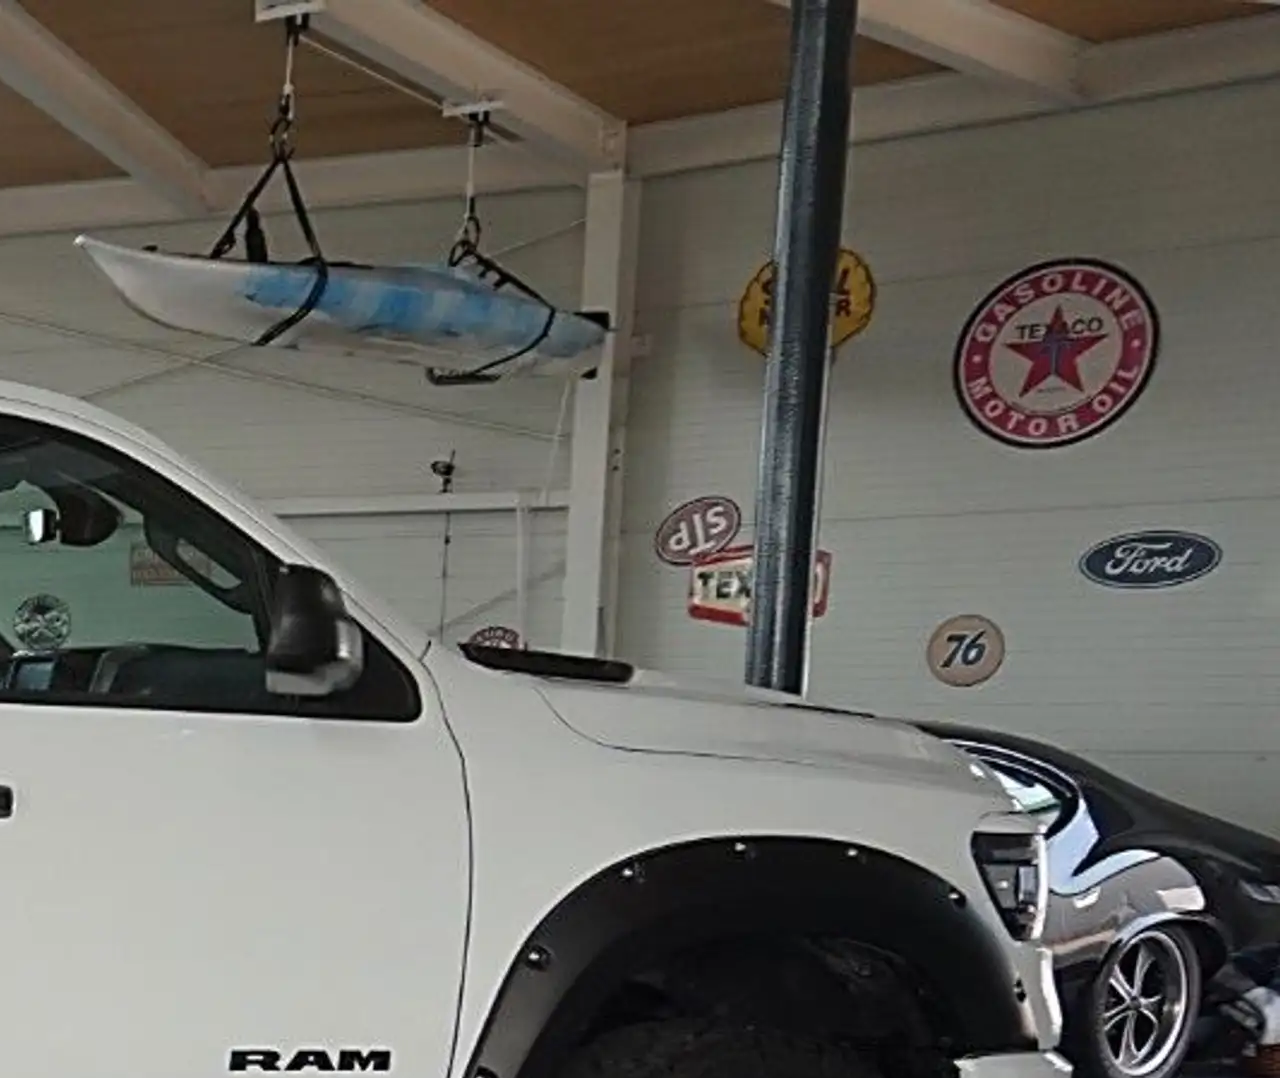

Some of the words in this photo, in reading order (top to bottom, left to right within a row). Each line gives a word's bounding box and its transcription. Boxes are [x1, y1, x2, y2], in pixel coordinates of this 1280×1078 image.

[975, 271, 1143, 343] GASOLINE
[1015, 317, 1104, 340] TEXCO
[969, 376, 1079, 436] MOTOR
[1092, 366, 1138, 413] OIL
[669, 505, 728, 554] STP
[1104, 541, 1193, 575] Ford
[940, 630, 987, 669] 76
[229, 1050, 391, 1071] RAM
